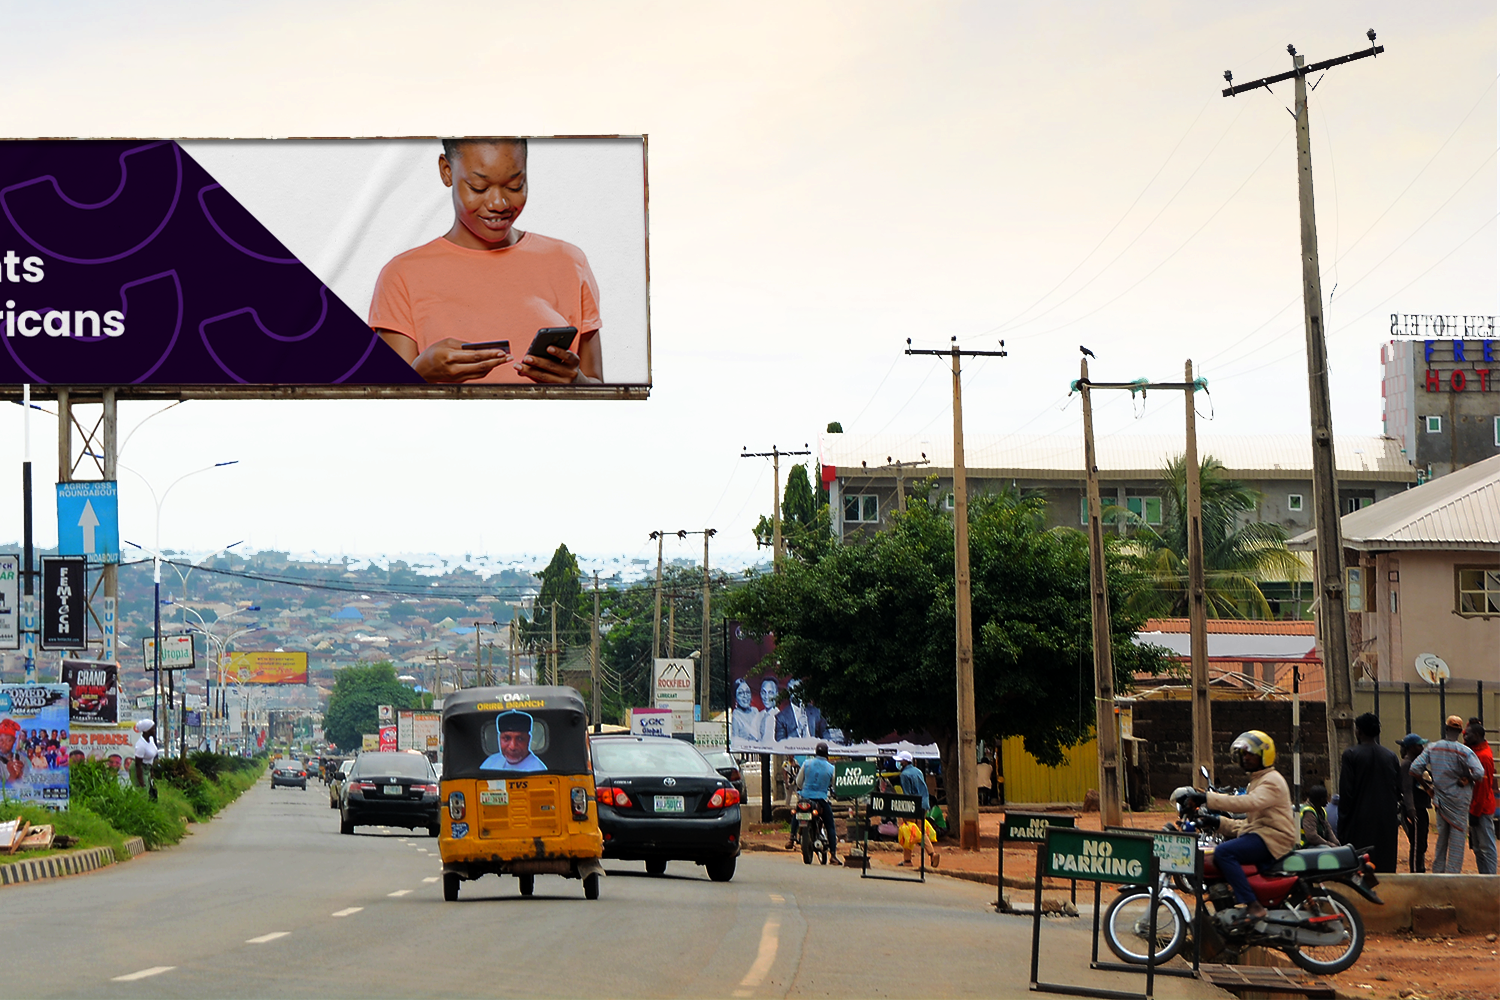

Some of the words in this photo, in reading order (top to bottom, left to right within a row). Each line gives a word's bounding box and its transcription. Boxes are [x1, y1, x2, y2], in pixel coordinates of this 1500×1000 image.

[1424, 338, 1495, 363] FRE
[1425, 369, 1490, 393] HOT
[63, 482, 90, 491] AGRIC
[58, 488, 117, 498] ROUNDABOUT
[76, 670, 107, 686] GRAND
[657, 679, 691, 688] ROCKFIELD
[3, 688, 53, 699] COMEDY
[505, 699, 545, 710] BRANCH
[844, 767, 862, 779] NO
[508, 780, 529, 790] TVS
[835, 774, 875, 787] PARKING
[872, 796, 885, 811] NO
[890, 799, 916, 814] PARKING
[1029, 818, 1050, 829] NO
[1175, 835, 1192, 845] FOR
[1082, 839, 1113, 857] NO
[1052, 852, 1143, 878] PARKING
